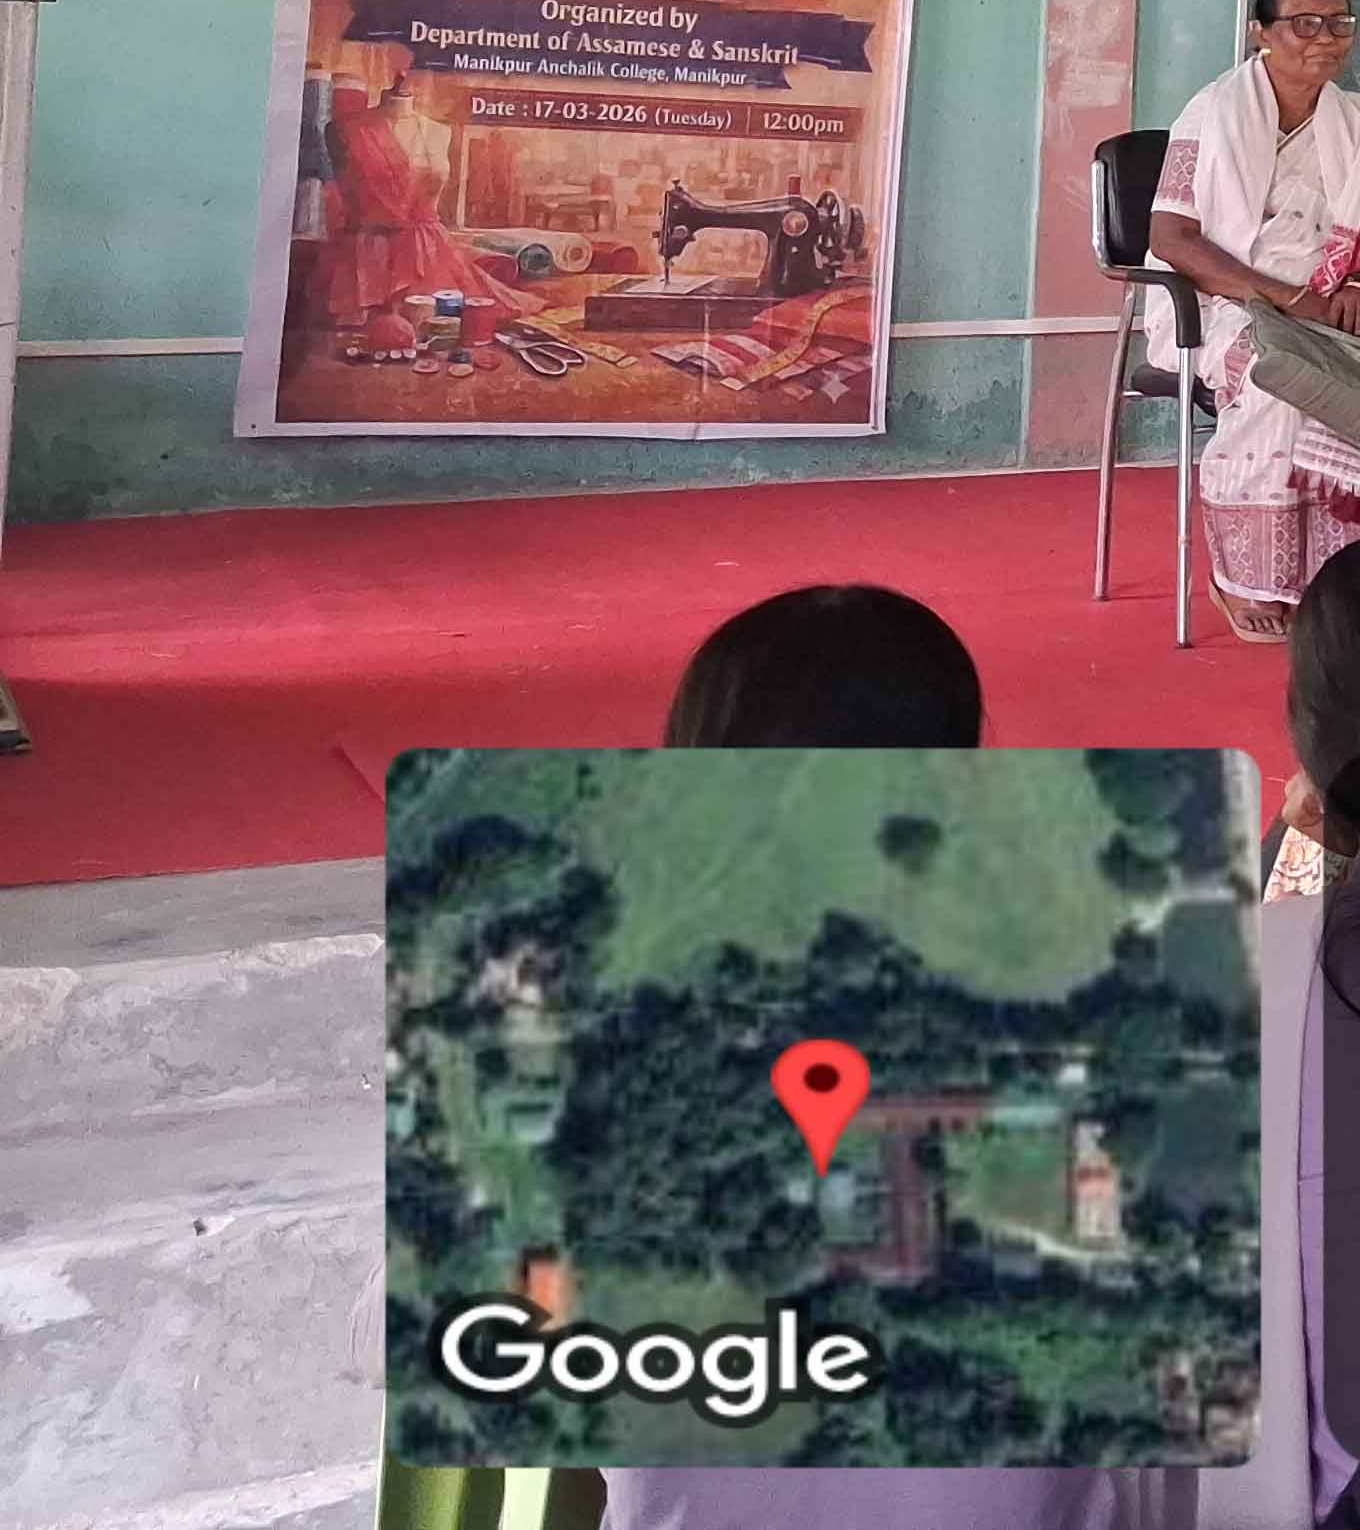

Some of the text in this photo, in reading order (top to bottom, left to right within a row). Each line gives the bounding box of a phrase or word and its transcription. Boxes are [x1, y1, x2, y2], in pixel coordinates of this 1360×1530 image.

[670, 6, 699, 33] by
[410, 21, 798, 65] Department of Assamese & Sanskrit
[453, 53, 747, 88] Manikpur Anchalik College, Manikpur
[471, 97, 515, 117] Date
[534, 101, 647, 122] 17-03-2026
[655, 106, 732, 130] (Tuesday)
[763, 112, 844, 136] 12:00pm
